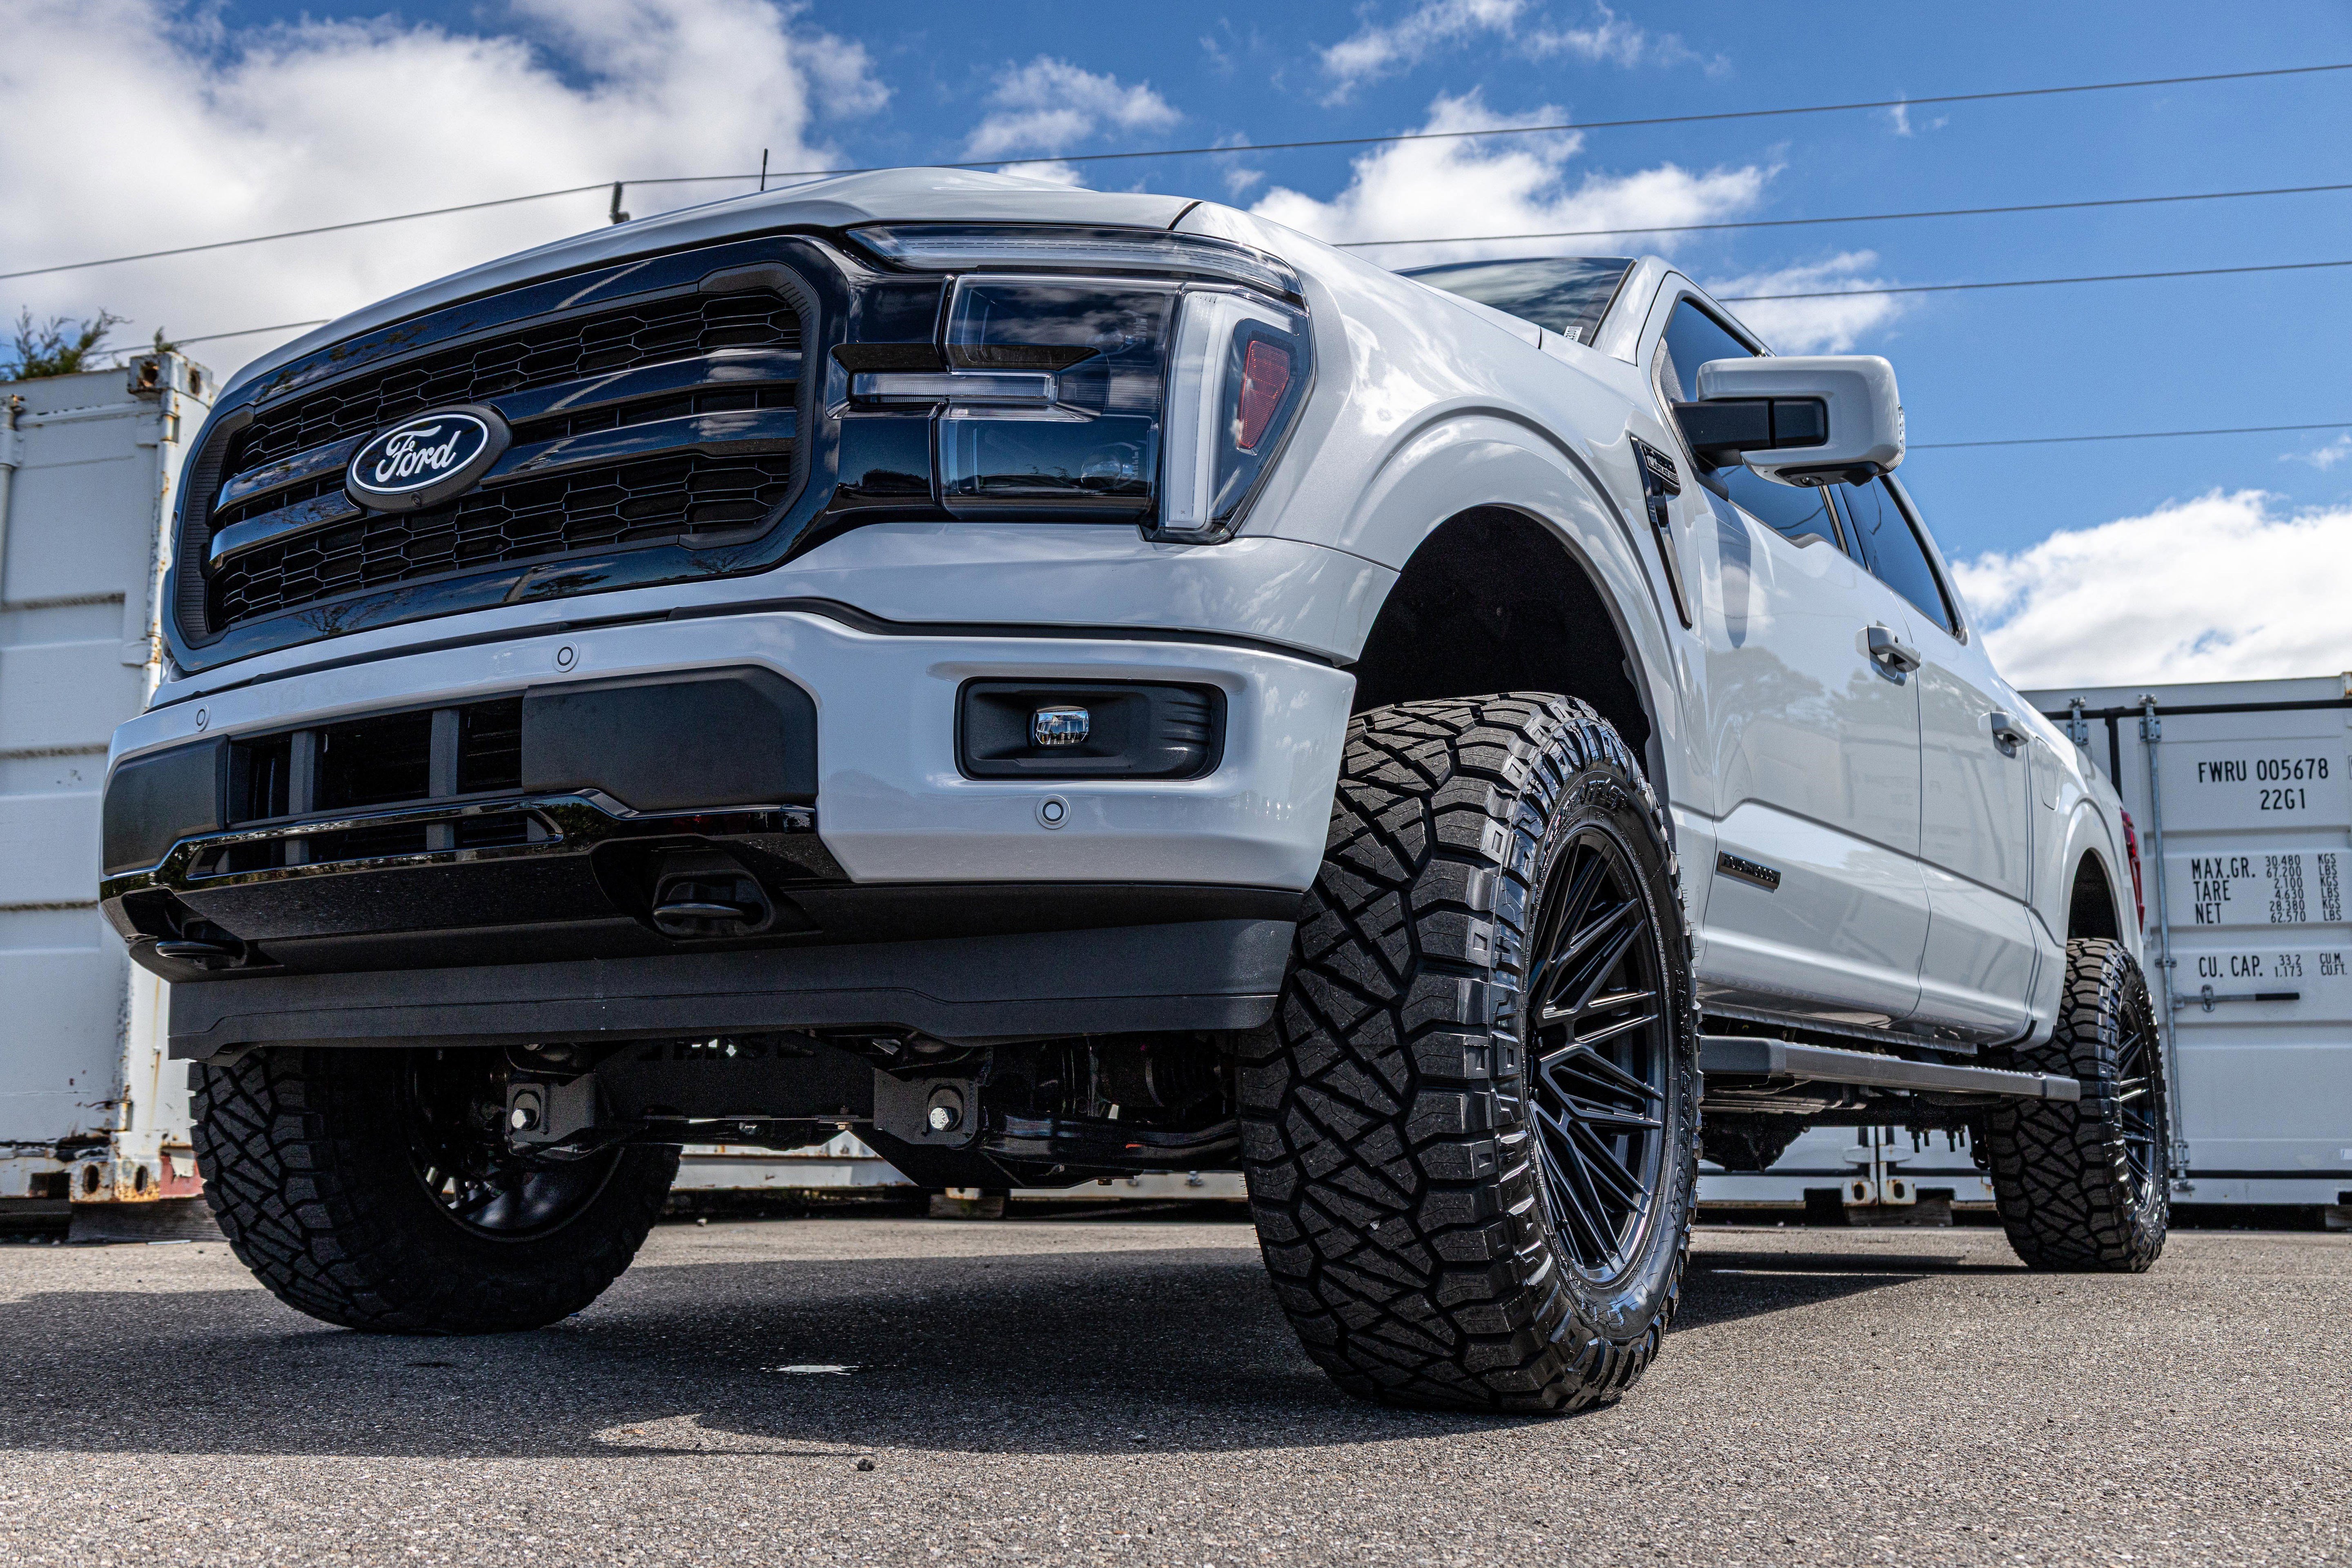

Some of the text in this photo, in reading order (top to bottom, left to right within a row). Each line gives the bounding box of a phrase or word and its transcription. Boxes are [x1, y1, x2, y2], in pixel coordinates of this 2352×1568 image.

[375, 425, 461, 482] Ford
[1648, 459, 1669, 477] LARIAT
[2198, 758, 2329, 783] FWRU 005678
[2260, 788, 2305, 810] 22G1
[2266, 855, 2301, 866] 30.480
[2318, 853, 2336, 864] KGS
[2267, 864, 2338, 878] 67.200 LBS
[2194, 876, 2339, 902] TARE 2.100 KGS
[2275, 888, 2340, 900] 4.630 LBS
[2195, 898, 2341, 924] NET 28.380 KGS
[2271, 910, 2342, 923] 62.570 LBS
[2199, 956, 2223, 978] CU.
[2231, 955, 2263, 977] CAP.
